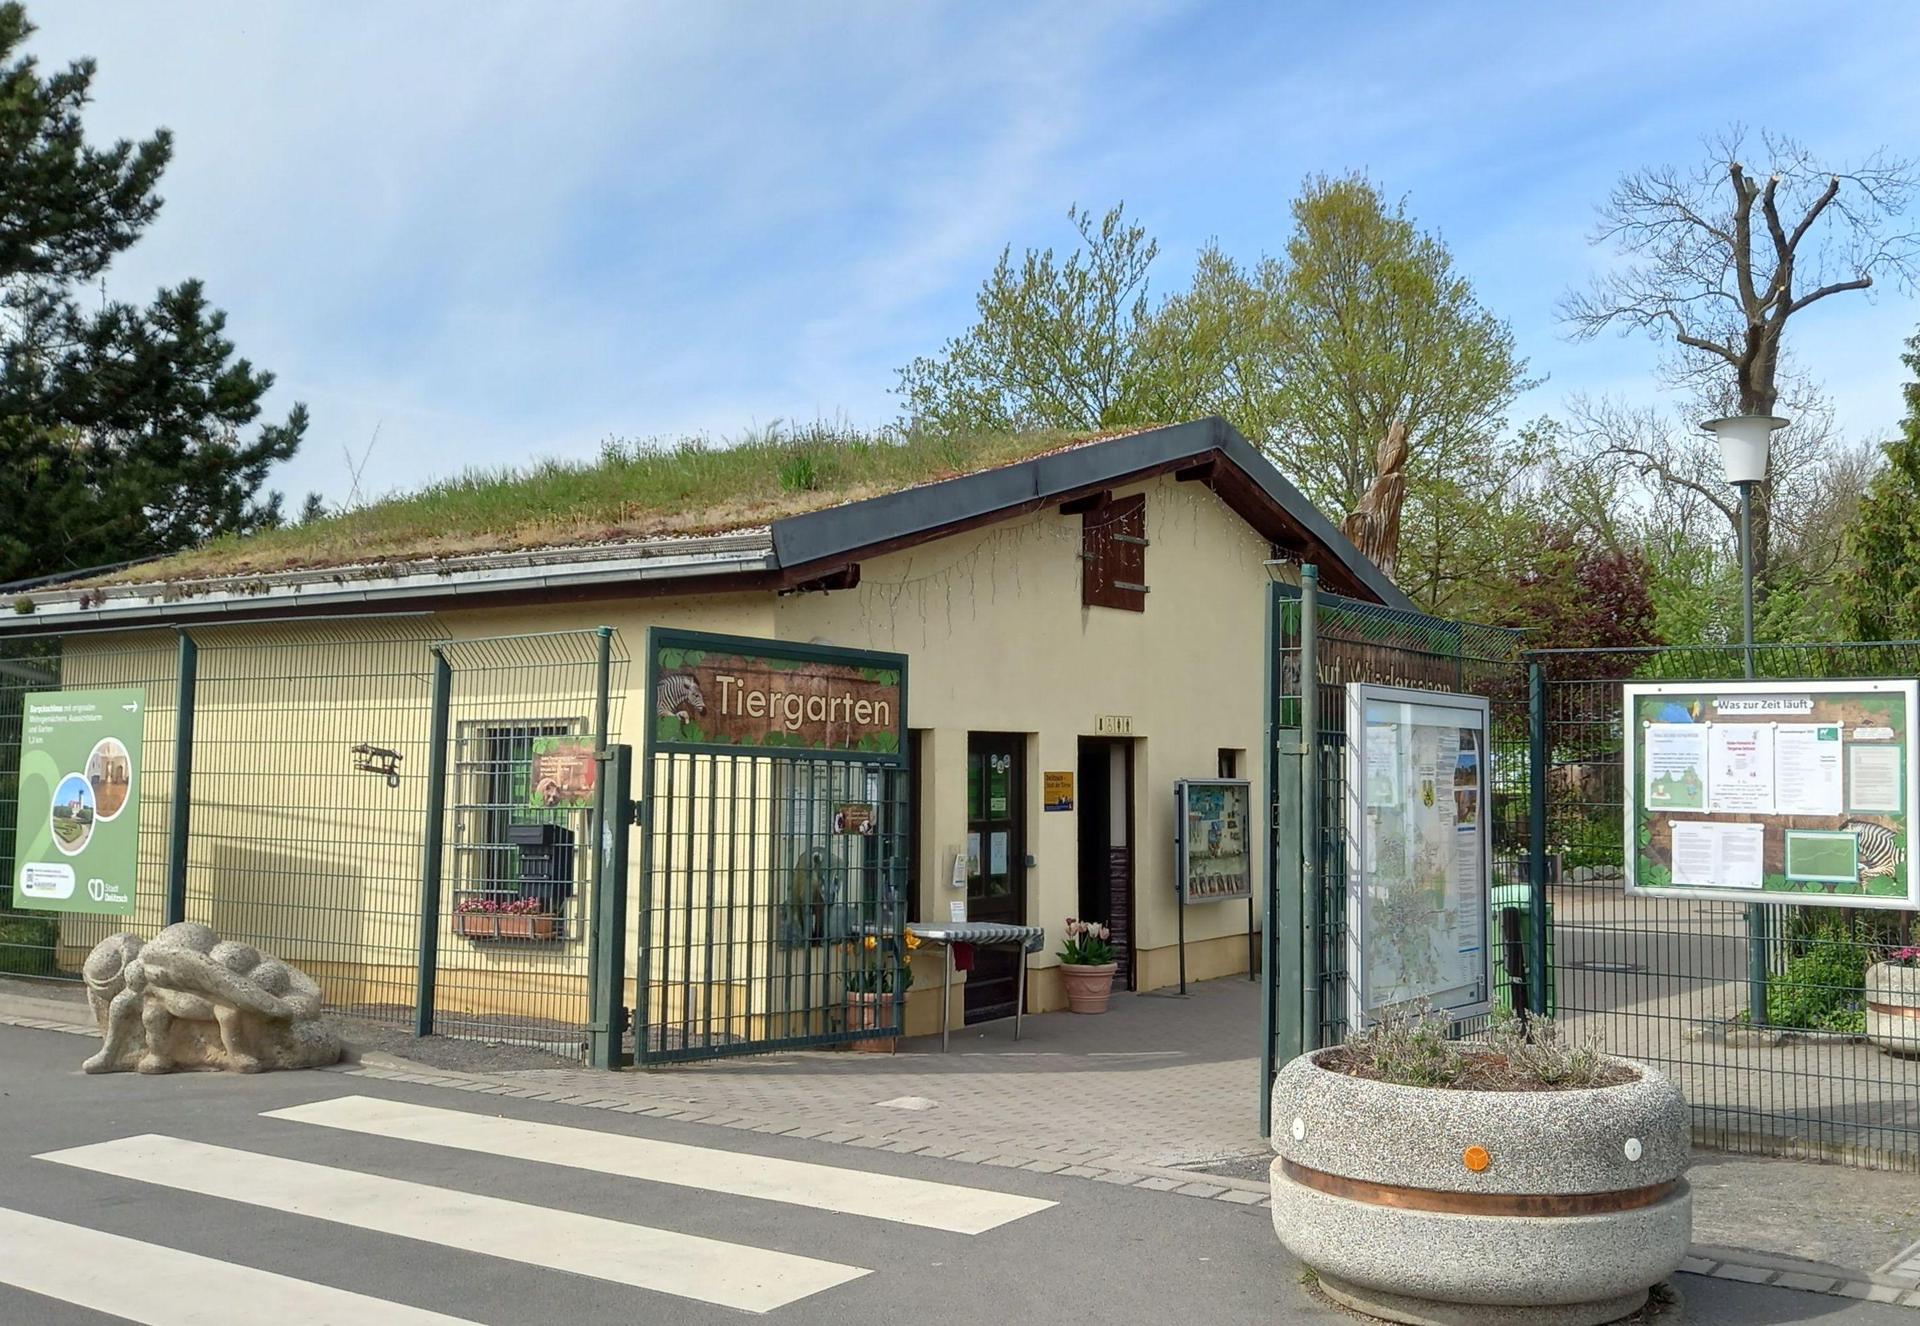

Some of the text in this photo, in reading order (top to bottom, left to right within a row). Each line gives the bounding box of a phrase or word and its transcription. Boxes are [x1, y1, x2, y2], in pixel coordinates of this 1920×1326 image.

[715, 674, 890, 731] Tiergarten
[1719, 699, 1808, 710] Was zur Zeit läuft
